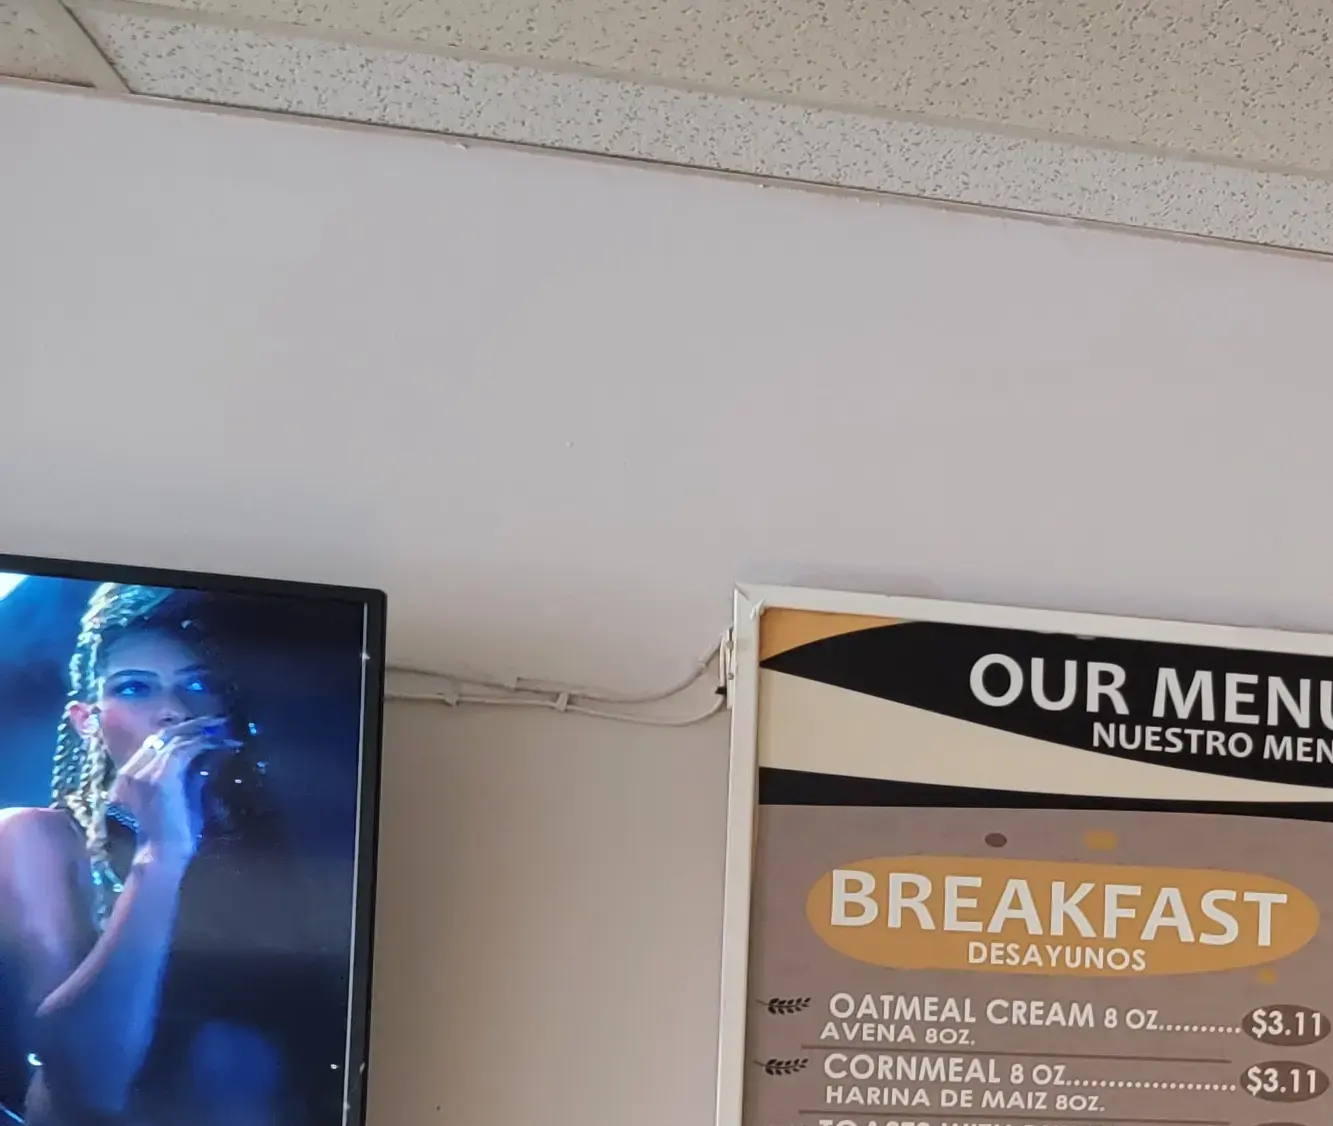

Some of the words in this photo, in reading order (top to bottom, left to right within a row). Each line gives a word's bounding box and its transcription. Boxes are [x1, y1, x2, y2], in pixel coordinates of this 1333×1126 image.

[970, 653, 1129, 715] OUR
[1092, 722, 1253, 758] NUESTRO
[831, 869, 1287, 946] BREAKFAST
[969, 941, 1146, 971] DESAYUNOS
[820, 1022, 916, 1043] AVENA
[830, 993, 976, 1023] OATMEAL
[987, 999, 1094, 1027] CREAM
[1252, 1008, 1320, 1038] $3.11
[824, 1053, 1001, 1083] CORNMEAL
[1247, 1066, 1316, 1096] $3.11
[826, 1086, 930, 1106] HARINA
[941, 1089, 973, 1107] DE
[981, 1090, 1047, 1109] MAIZ
[1055, 1095, 1105, 1111] 8OZ.
